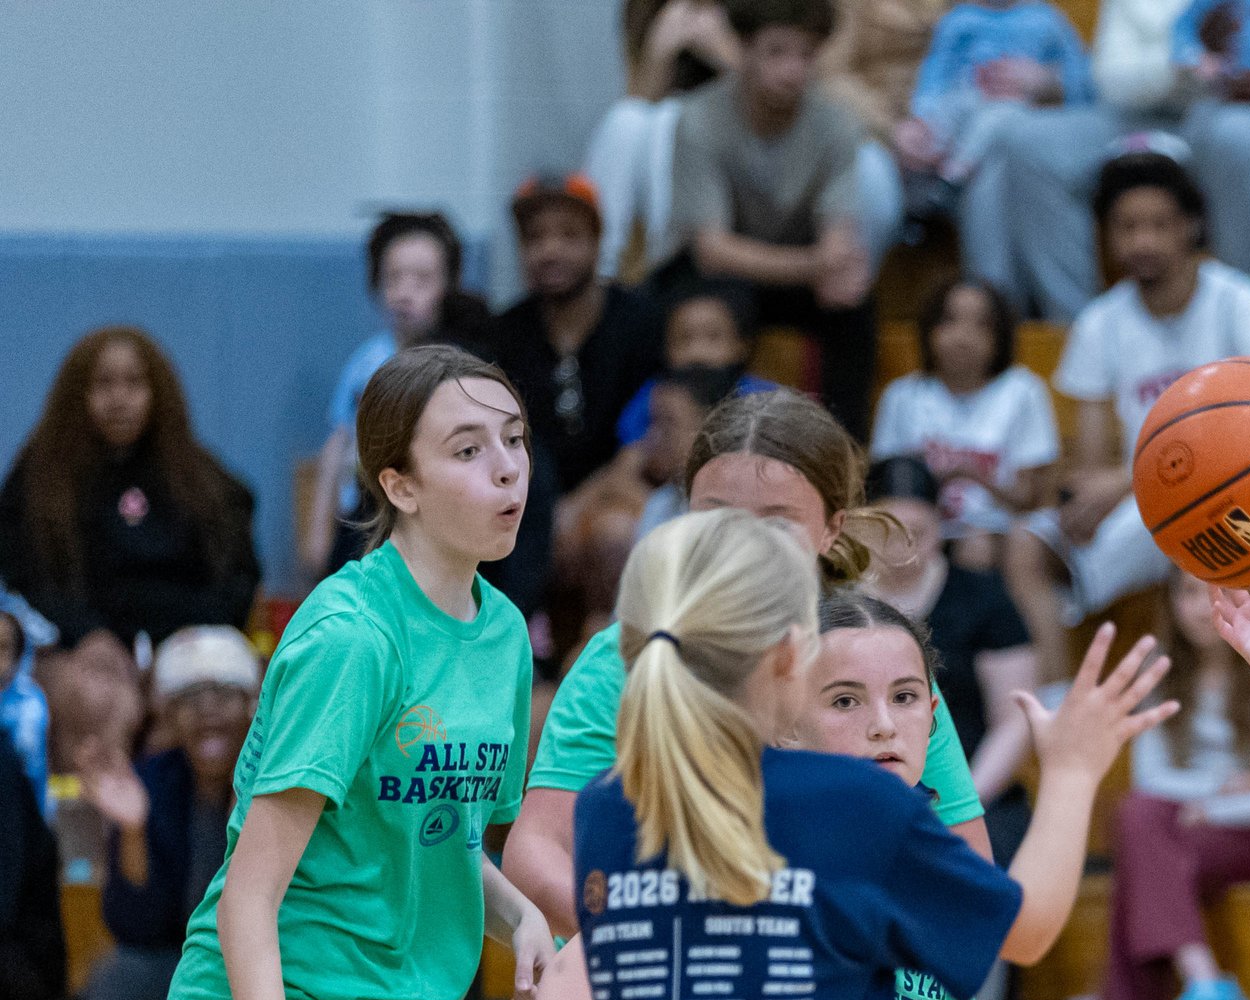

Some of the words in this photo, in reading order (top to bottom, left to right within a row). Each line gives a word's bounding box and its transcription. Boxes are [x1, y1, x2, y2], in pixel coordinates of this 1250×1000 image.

[1181, 522, 1250, 572] NBA
[415, 742, 470, 772] ALL
[607, 869, 680, 910] 2026
